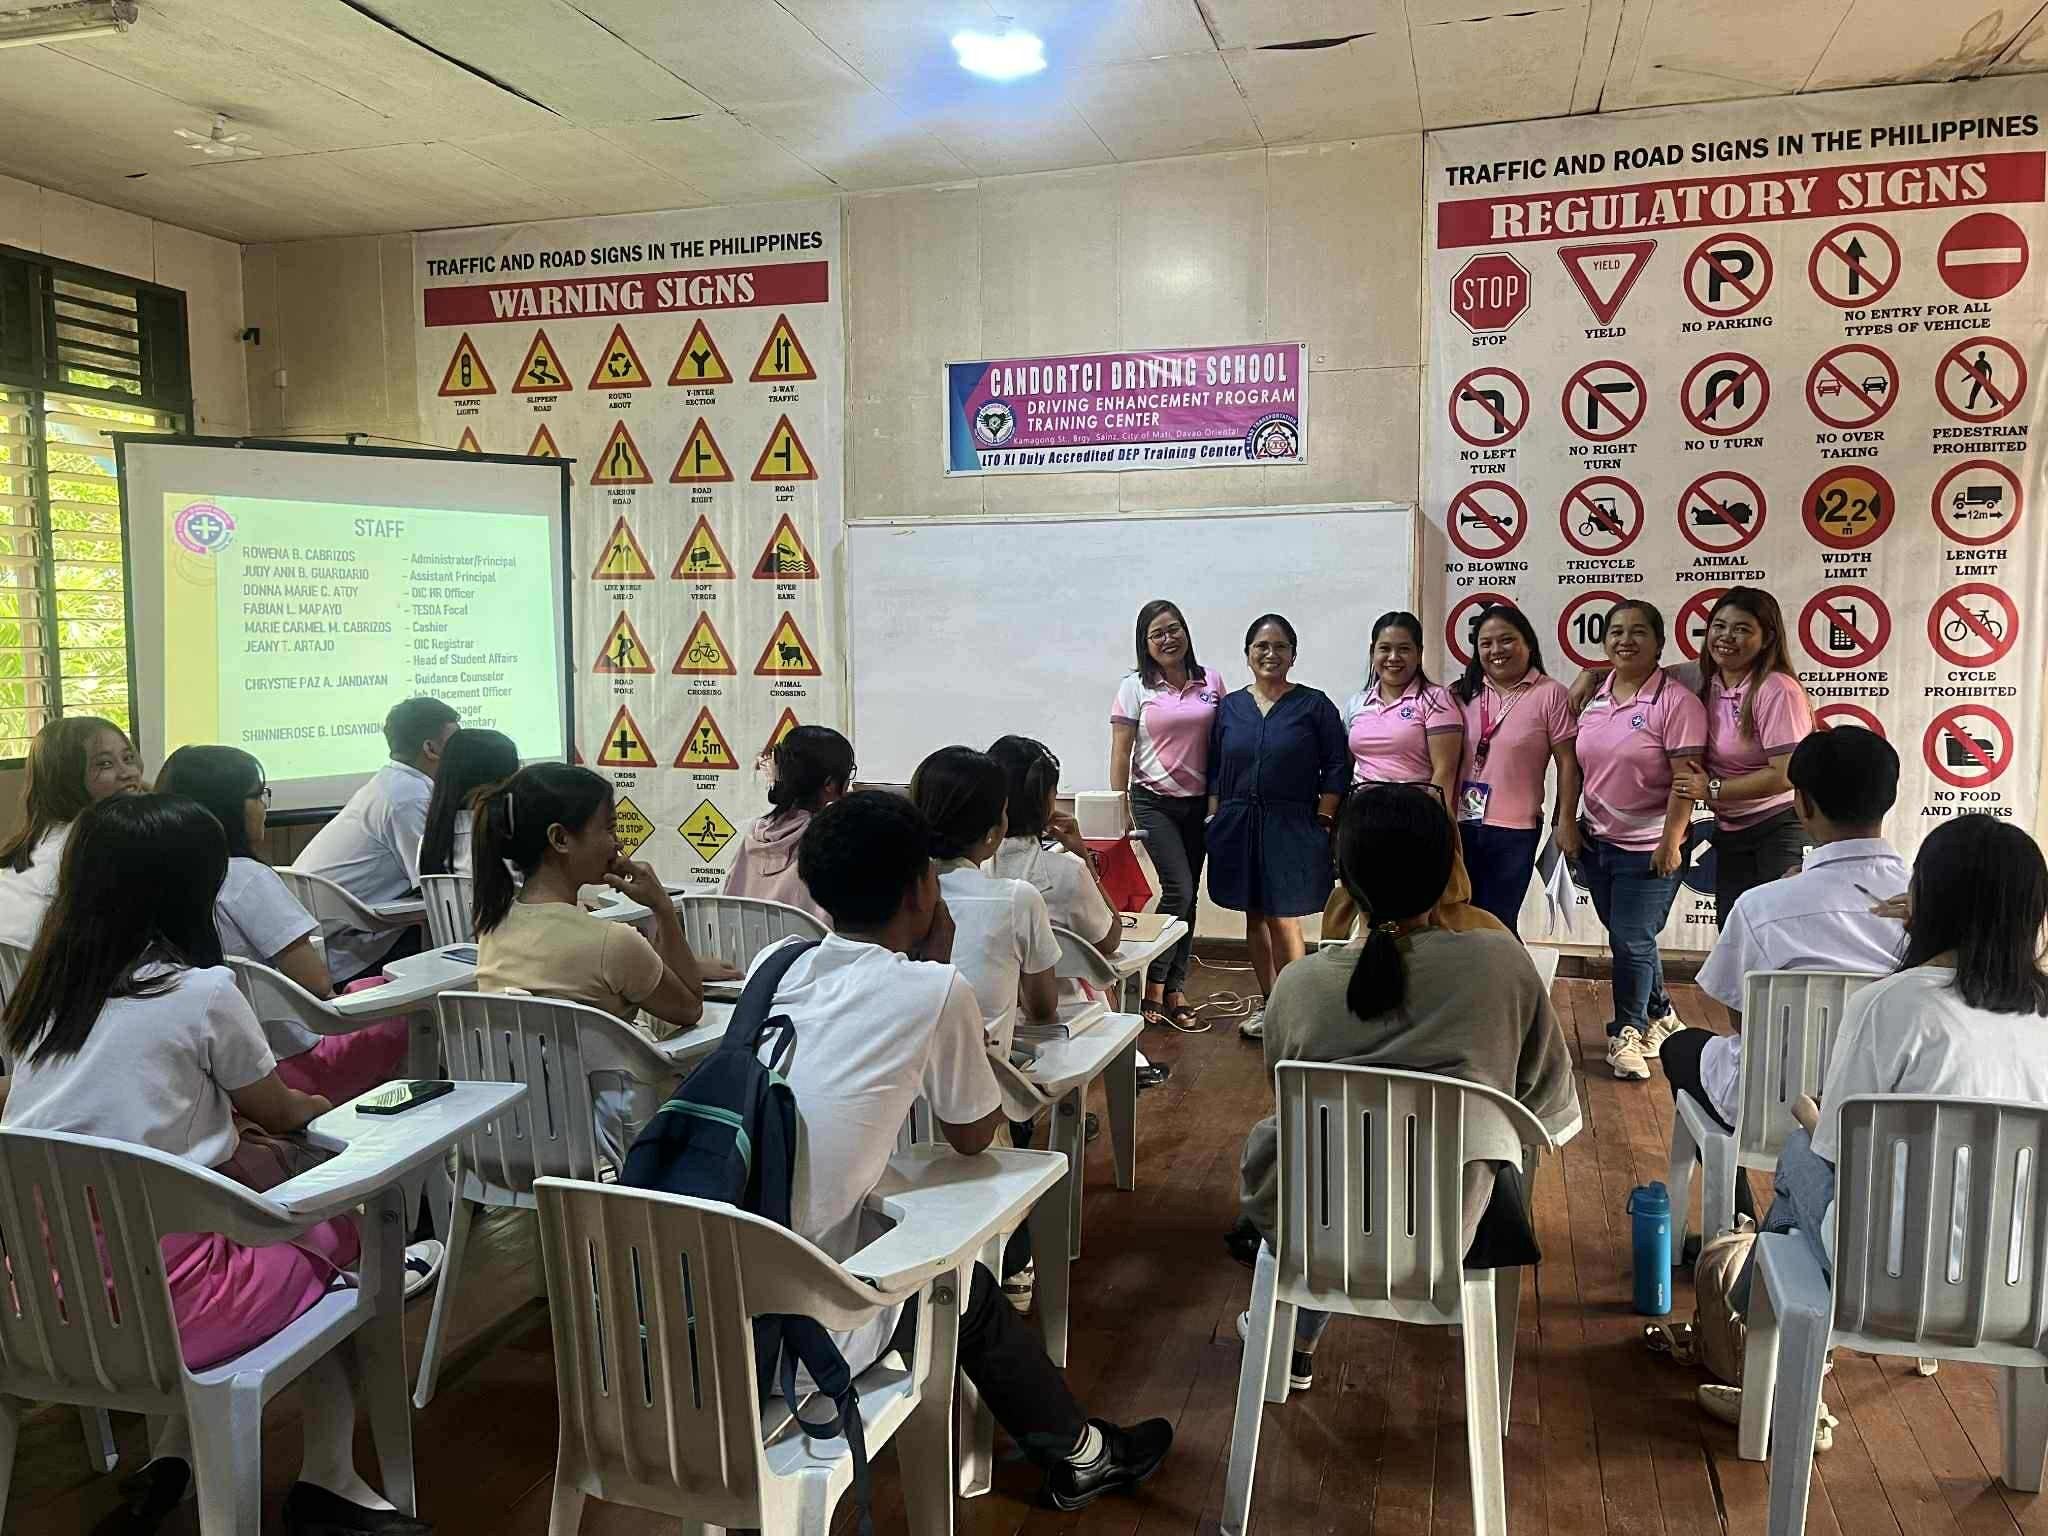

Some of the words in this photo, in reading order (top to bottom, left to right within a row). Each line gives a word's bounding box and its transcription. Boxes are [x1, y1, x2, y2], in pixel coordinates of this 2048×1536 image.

[1446, 159, 1546, 186] TRAFFIC
[1553, 154, 1607, 175] AND
[1613, 146, 1684, 171] ROAD
[1691, 139, 1768, 163] SIGNS
[1777, 135, 1803, 154] IN
[1811, 129, 1862, 152] THE
[1870, 115, 2038, 147] PHILIPPINES
[1490, 176, 1818, 239] REGULATORY
[1837, 162, 1987, 209] SIGNS
[427, 258, 496, 276] TRAFFIC
[500, 255, 534, 272] AND
[539, 250, 586, 268] ROAD
[590, 245, 643, 265] SIGNS
[648, 243, 665, 261] IN
[670, 240, 704, 260] THE
[709, 231, 822, 256] PHILIPPINES
[1592, 258, 1620, 271] YIELD
[488, 280, 645, 319] WARNING
[656, 273, 755, 309] SIGNS
[1462, 276, 1519, 311] STOP
[1844, 309, 1865, 322] NO
[1870, 306, 1922, 320] ENTRY
[1926, 304, 1959, 317] FOR
[1962, 302, 1992, 315] ALL
[1682, 320, 1703, 333] NO
[1706, 316, 1773, 331] PARKING
[1844, 324, 1893, 337] TYPES
[1897, 321, 1918, 335] OF
[1922, 318, 1991, 333] VEHICLE
[1584, 326, 1626, 340] YIELD
[1472, 334, 1507, 347] STOP
[991, 362, 1101, 397] CANDORTCI
[1111, 357, 1197, 390] DRIVING
[1207, 352, 1287, 386] SCHOOL
[608, 392, 632, 400] ROUND
[685, 398, 716, 406] SECTION
[768, 395, 799, 403] TRAFFIC
[1027, 399, 1090, 415] DRIVING
[1096, 391, 1210, 411] ENHANCEMENT
[1215, 388, 1295, 405] PROGRAM
[608, 401, 632, 409] ABOUT
[1027, 415, 1100, 432] TRAINING
[1104, 412, 1160, 428] CENTER
[1204, 427, 1239, 436] Oriental
[1816, 434, 1838, 444] NO
[1842, 431, 1885, 443] OVER
[1933, 425, 2028, 438] PEDESTRIAN
[1568, 444, 1590, 456] NO
[1594, 442, 1638, 455] RIGHT
[1684, 439, 1706, 451] NO
[1709, 438, 1721, 450] U
[1725, 437, 1764, 449] TURN
[1933, 441, 2027, 454] PROHIBITED
[981, 452, 1002, 467] LTO
[1019, 452, 1045, 465] Duly
[1048, 449, 1114, 464] Accredited
[1118, 448, 1140, 461] DEP
[1144, 446, 1196, 460] Training
[1201, 445, 1243, 457] Center
[1460, 450, 1480, 461] NO
[1484, 448, 1517, 461] LEFT
[1821, 446, 1879, 458] TAKING
[1470, 462, 1506, 475] TURN
[1583, 457, 1622, 470] TURN
[775, 485, 795, 493] ROAD
[612, 497, 632, 505] ROAD
[691, 496, 713, 504] RIGHT
[1967, 510, 1988, 520] 12m
[354, 518, 404, 538] STAFF
[242, 546, 289, 560] ROWENA
[305, 549, 355, 562] CABRIZOS
[411, 553, 516, 568] Administrator/Principal
[1821, 552, 1872, 563] WIDTH
[1946, 550, 2008, 561] LENGTH
[1445, 562, 1467, 573] NO
[1469, 560, 1529, 573] BLOWING
[1567, 558, 1636, 571] TRICYCLE
[1692, 555, 1749, 568] ANIMAL
[242, 566, 270, 577] JUDY
[273, 567, 295, 578] ANN
[410, 570, 453, 581] Assistant
[455, 571, 497, 584] Principal
[1675, 568, 1765, 582] PROHIBITED
[1824, 567, 1868, 579] LIMIT
[1955, 565, 1998, 576] LIMIT
[1456, 575, 1478, 587] OF
[1480, 574, 1517, 586] HORN
[1558, 572, 1644, 585] PROHIBITED
[243, 584, 282, 596] DONNA
[284, 585, 318, 597] MARIE
[333, 586, 358, 597] ATOY
[429, 587, 442, 598] HR
[444, 588, 474, 599] Officer
[243, 603, 283, 615] FABIAN
[298, 603, 342, 615] MAPAYO
[443, 604, 468, 615] Focal
[244, 621, 280, 633] MARIE
[283, 621, 326, 633] CARMEL
[343, 621, 391, 633] CABRIZOS
[412, 621, 448, 632] Cashier
[294, 639, 335, 651] ARTAJO
[431, 639, 474, 651] Registrar
[414, 654, 437, 666] Head
[440, 654, 449, 665] of
[450, 653, 486, 665] Student
[488, 653, 518, 664] Affairs
[245, 677, 297, 690] CHRYSTIE
[300, 677, 320, 688] PAZ
[336, 674, 388, 687] JANDAYAN
[415, 673, 458, 684] Guidance
[460, 672, 504, 683] Counselor
[1798, 672, 1888, 682] CELLPHONE
[1948, 671, 1996, 682] CYCLE
[431, 687, 480, 699] Placement
[482, 686, 512, 697] Officer
[770, 689, 807, 697] CROSSING
[1924, 686, 2017, 697] PROHIBITED
[242, 726, 315, 742] SHINNIEROSE
[690, 740, 721, 755] 4.5m
[1934, 791, 1955, 801] NO
[1960, 791, 2001, 801] FOOD
[1920, 807, 1952, 816] AND
